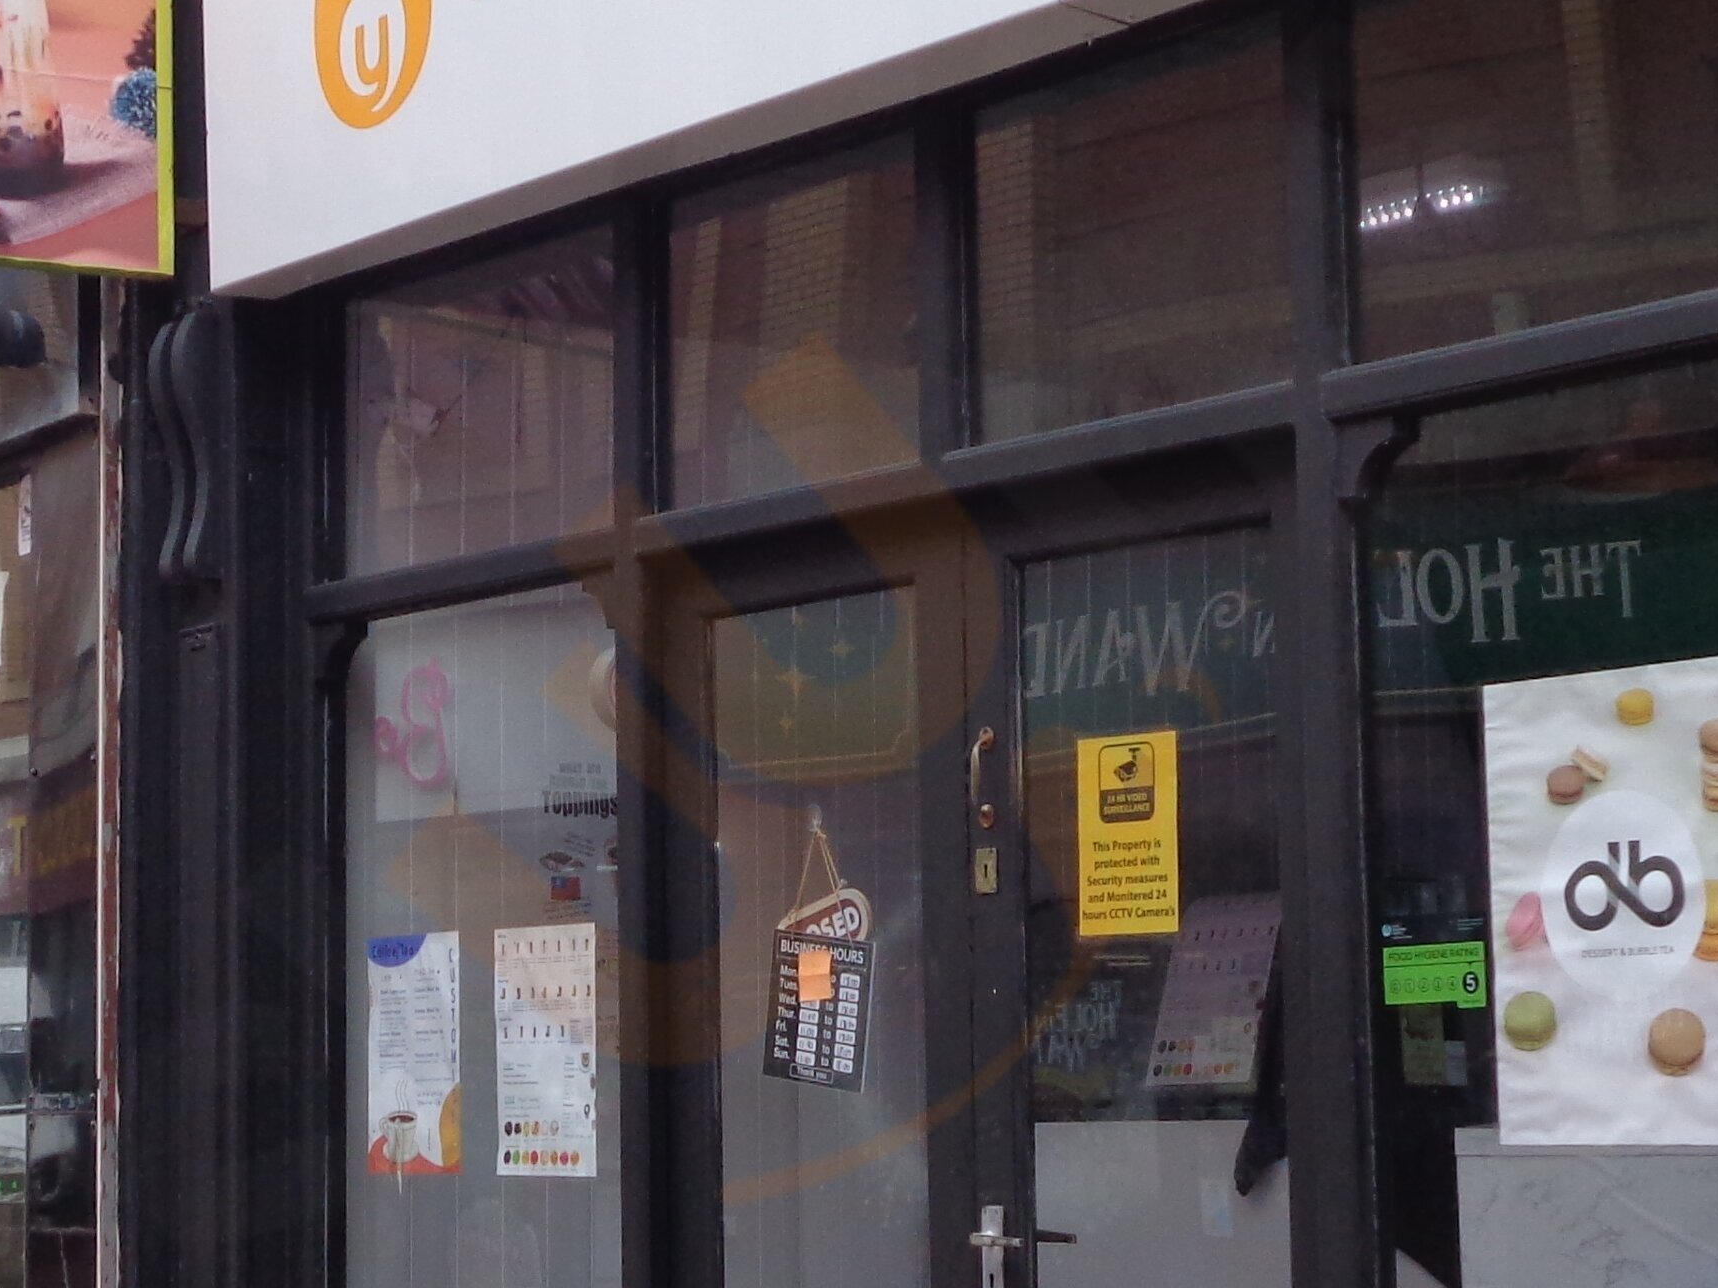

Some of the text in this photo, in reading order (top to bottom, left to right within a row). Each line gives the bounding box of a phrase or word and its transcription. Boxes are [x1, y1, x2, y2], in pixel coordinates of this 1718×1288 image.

[1093, 838, 1161, 854] This Property is
[1094, 855, 1160, 871] protected with
[1087, 873, 1168, 888] Security measures
[1088, 891, 1104, 903] and
[1156, 889, 1167, 900] 24
[1082, 909, 1107, 921] hours
[1109, 908, 1133, 919] CCTV
[830, 947, 864, 964] HOURS
[1465, 974, 1477, 992] 5
[824, 1015, 833, 1025] to
[823, 1029, 832, 1040] to
[822, 1044, 830, 1055] to
[821, 1057, 829, 1067] to
